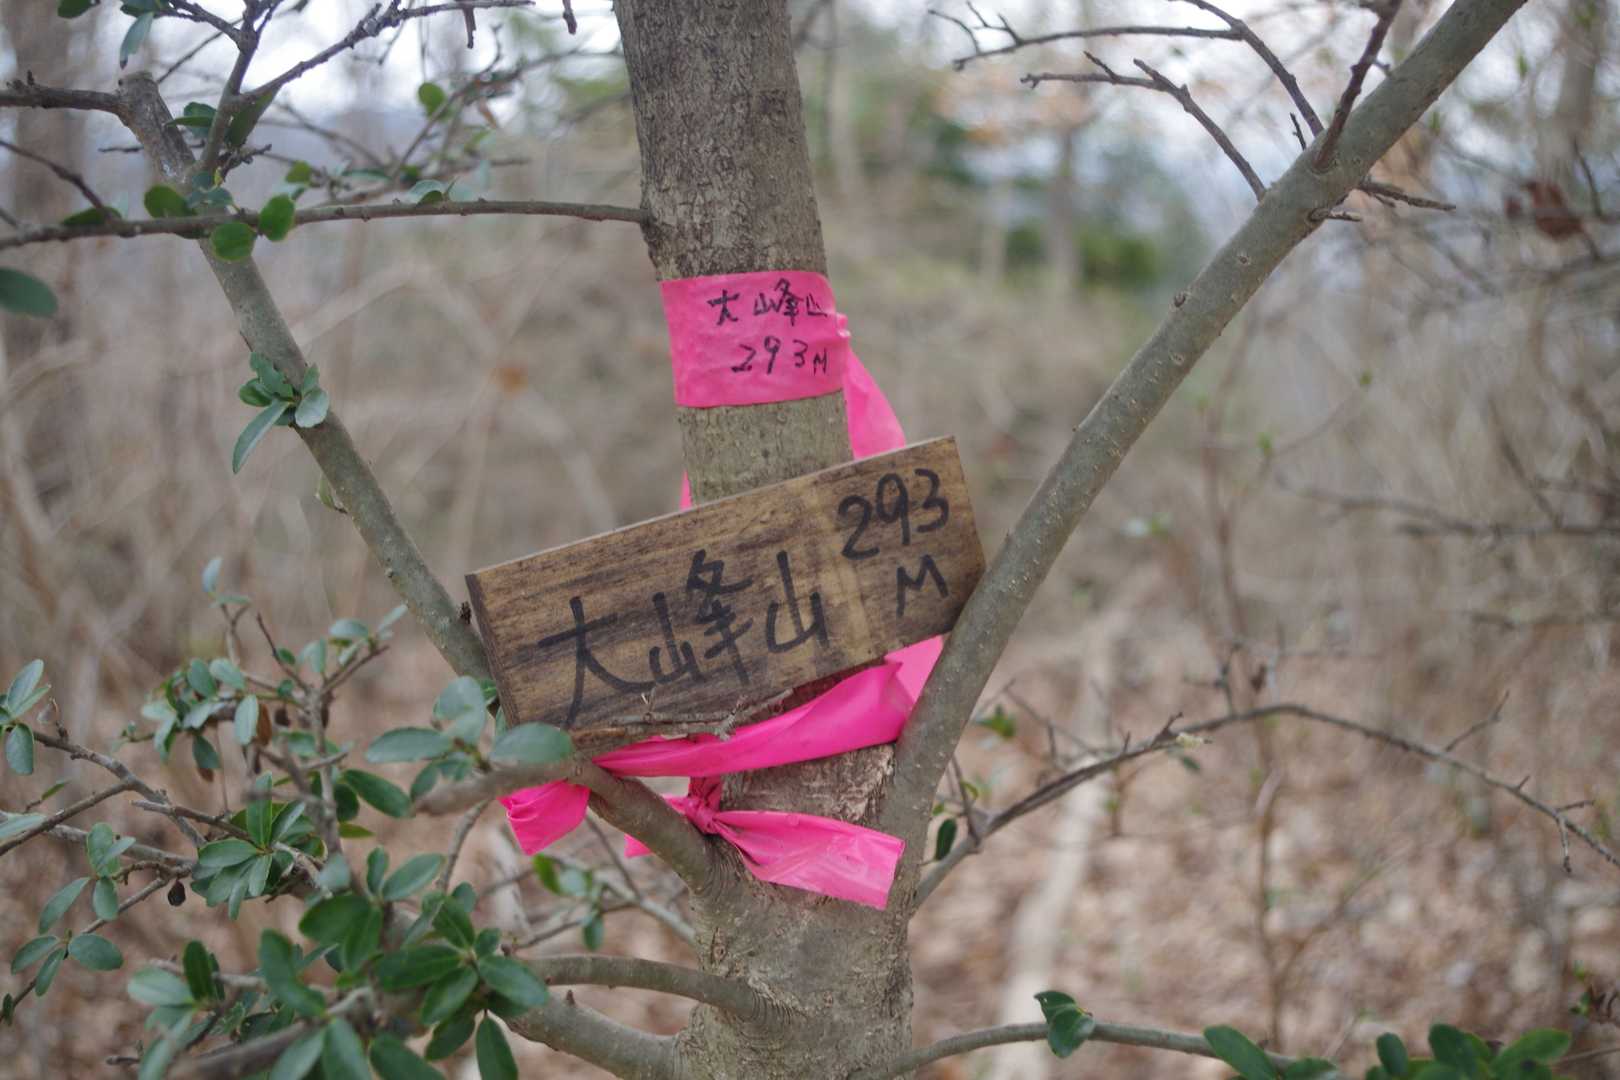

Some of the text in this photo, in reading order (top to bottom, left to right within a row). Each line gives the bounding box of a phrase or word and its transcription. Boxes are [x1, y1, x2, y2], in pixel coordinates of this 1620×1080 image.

[838, 468, 949, 561] 293
[895, 554, 949, 618] M
[537, 549, 830, 729] 大峰山
